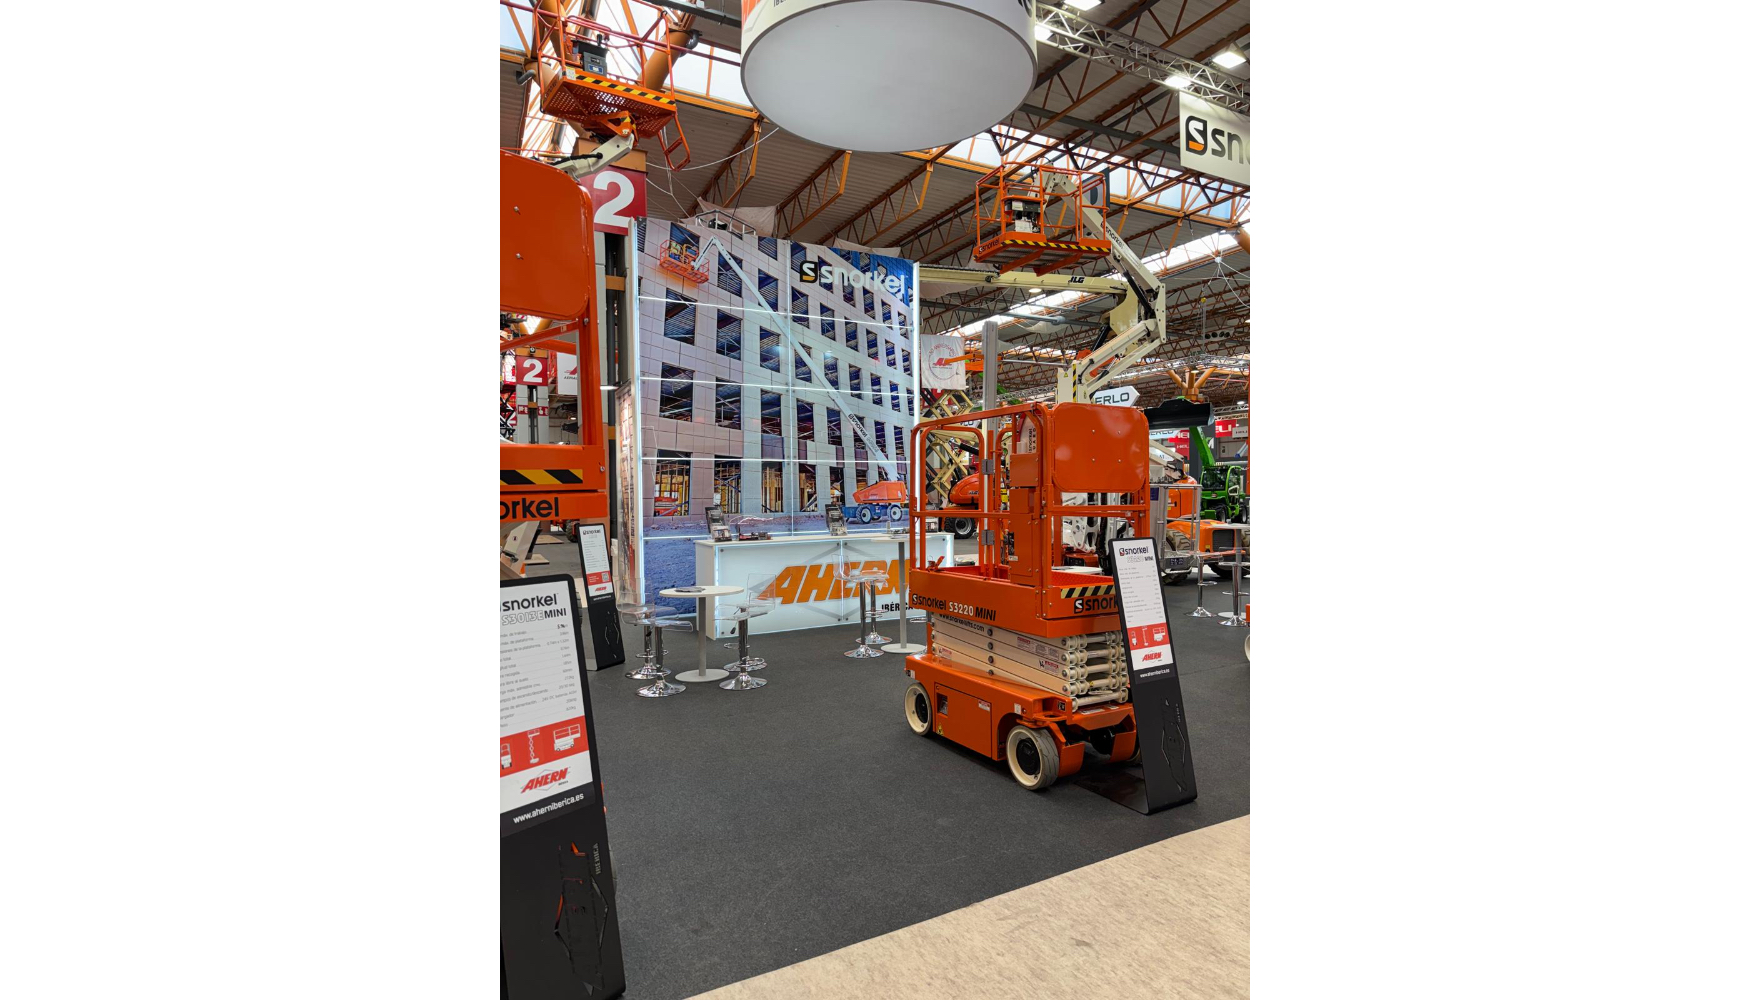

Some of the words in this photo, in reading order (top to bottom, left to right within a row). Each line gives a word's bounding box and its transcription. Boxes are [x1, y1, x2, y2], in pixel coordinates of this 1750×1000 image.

[593, 171, 635, 228] 2
[820, 265, 905, 294] snorkel
[1070, 276, 1085, 284] JLG
[523, 358, 543, 383] 2
[500, 497, 559, 520] orkel
[1125, 546, 1149, 555] snorkel
[502, 593, 558, 612] snorkel
[544, 608, 567, 620] MINI
[918, 595, 946, 611] snorkel
[949, 601, 974, 617] S3220
[975, 606, 997, 622] MINI
[1142, 651, 1162, 662] AHERN
[521, 766, 568, 794] AHERN
[513, 792, 585, 824] www.aherniberica.es
